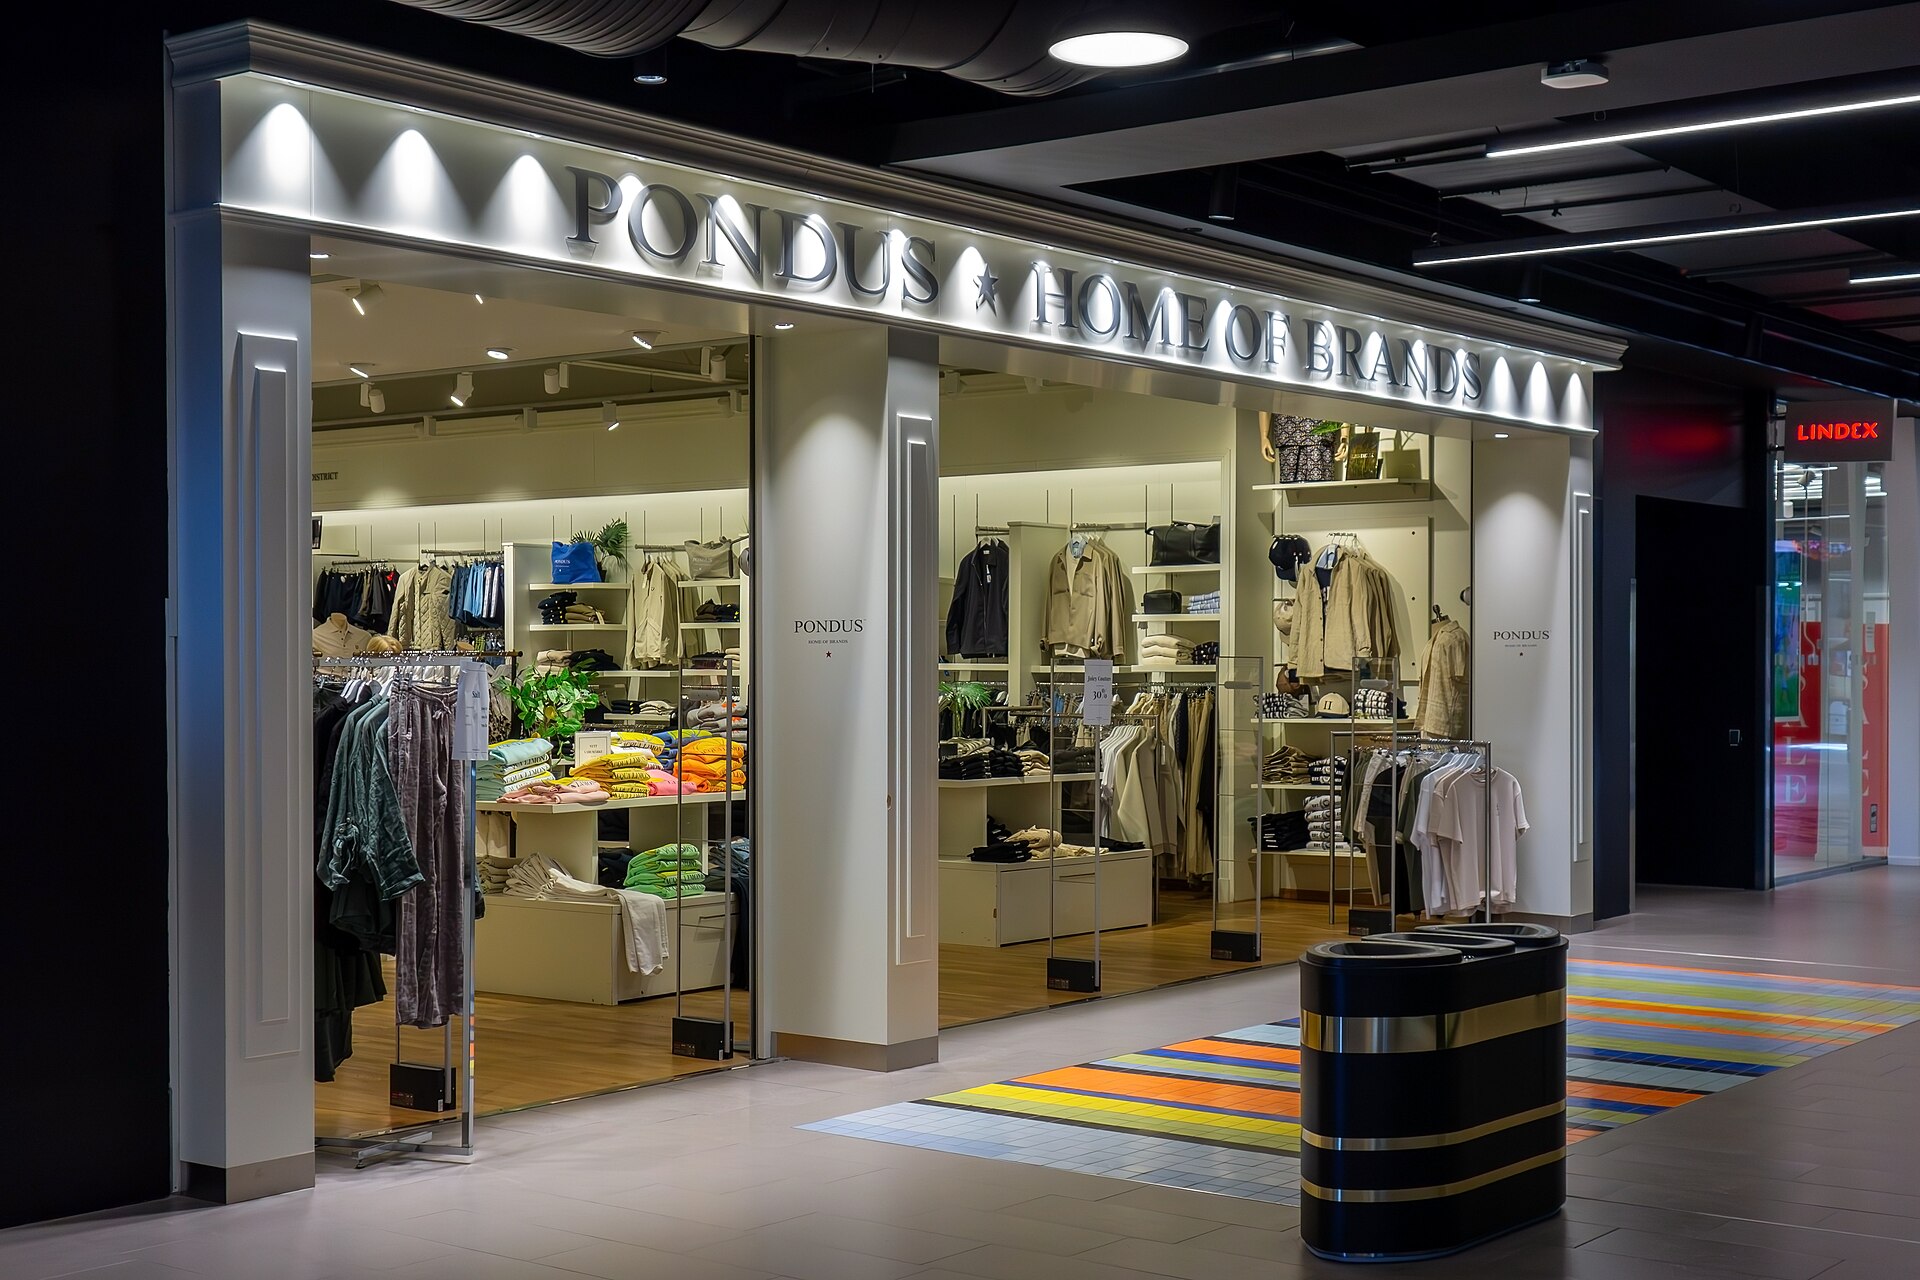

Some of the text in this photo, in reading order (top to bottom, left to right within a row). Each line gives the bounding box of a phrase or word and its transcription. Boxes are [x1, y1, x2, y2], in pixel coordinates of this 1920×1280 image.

[565, 166, 1481, 400] PONDUS HOME OF BRANDS
[1797, 422, 1878, 440] LINDEX
[794, 619, 863, 633] PONDUS
[1493, 630, 1550, 640] PONDUS
